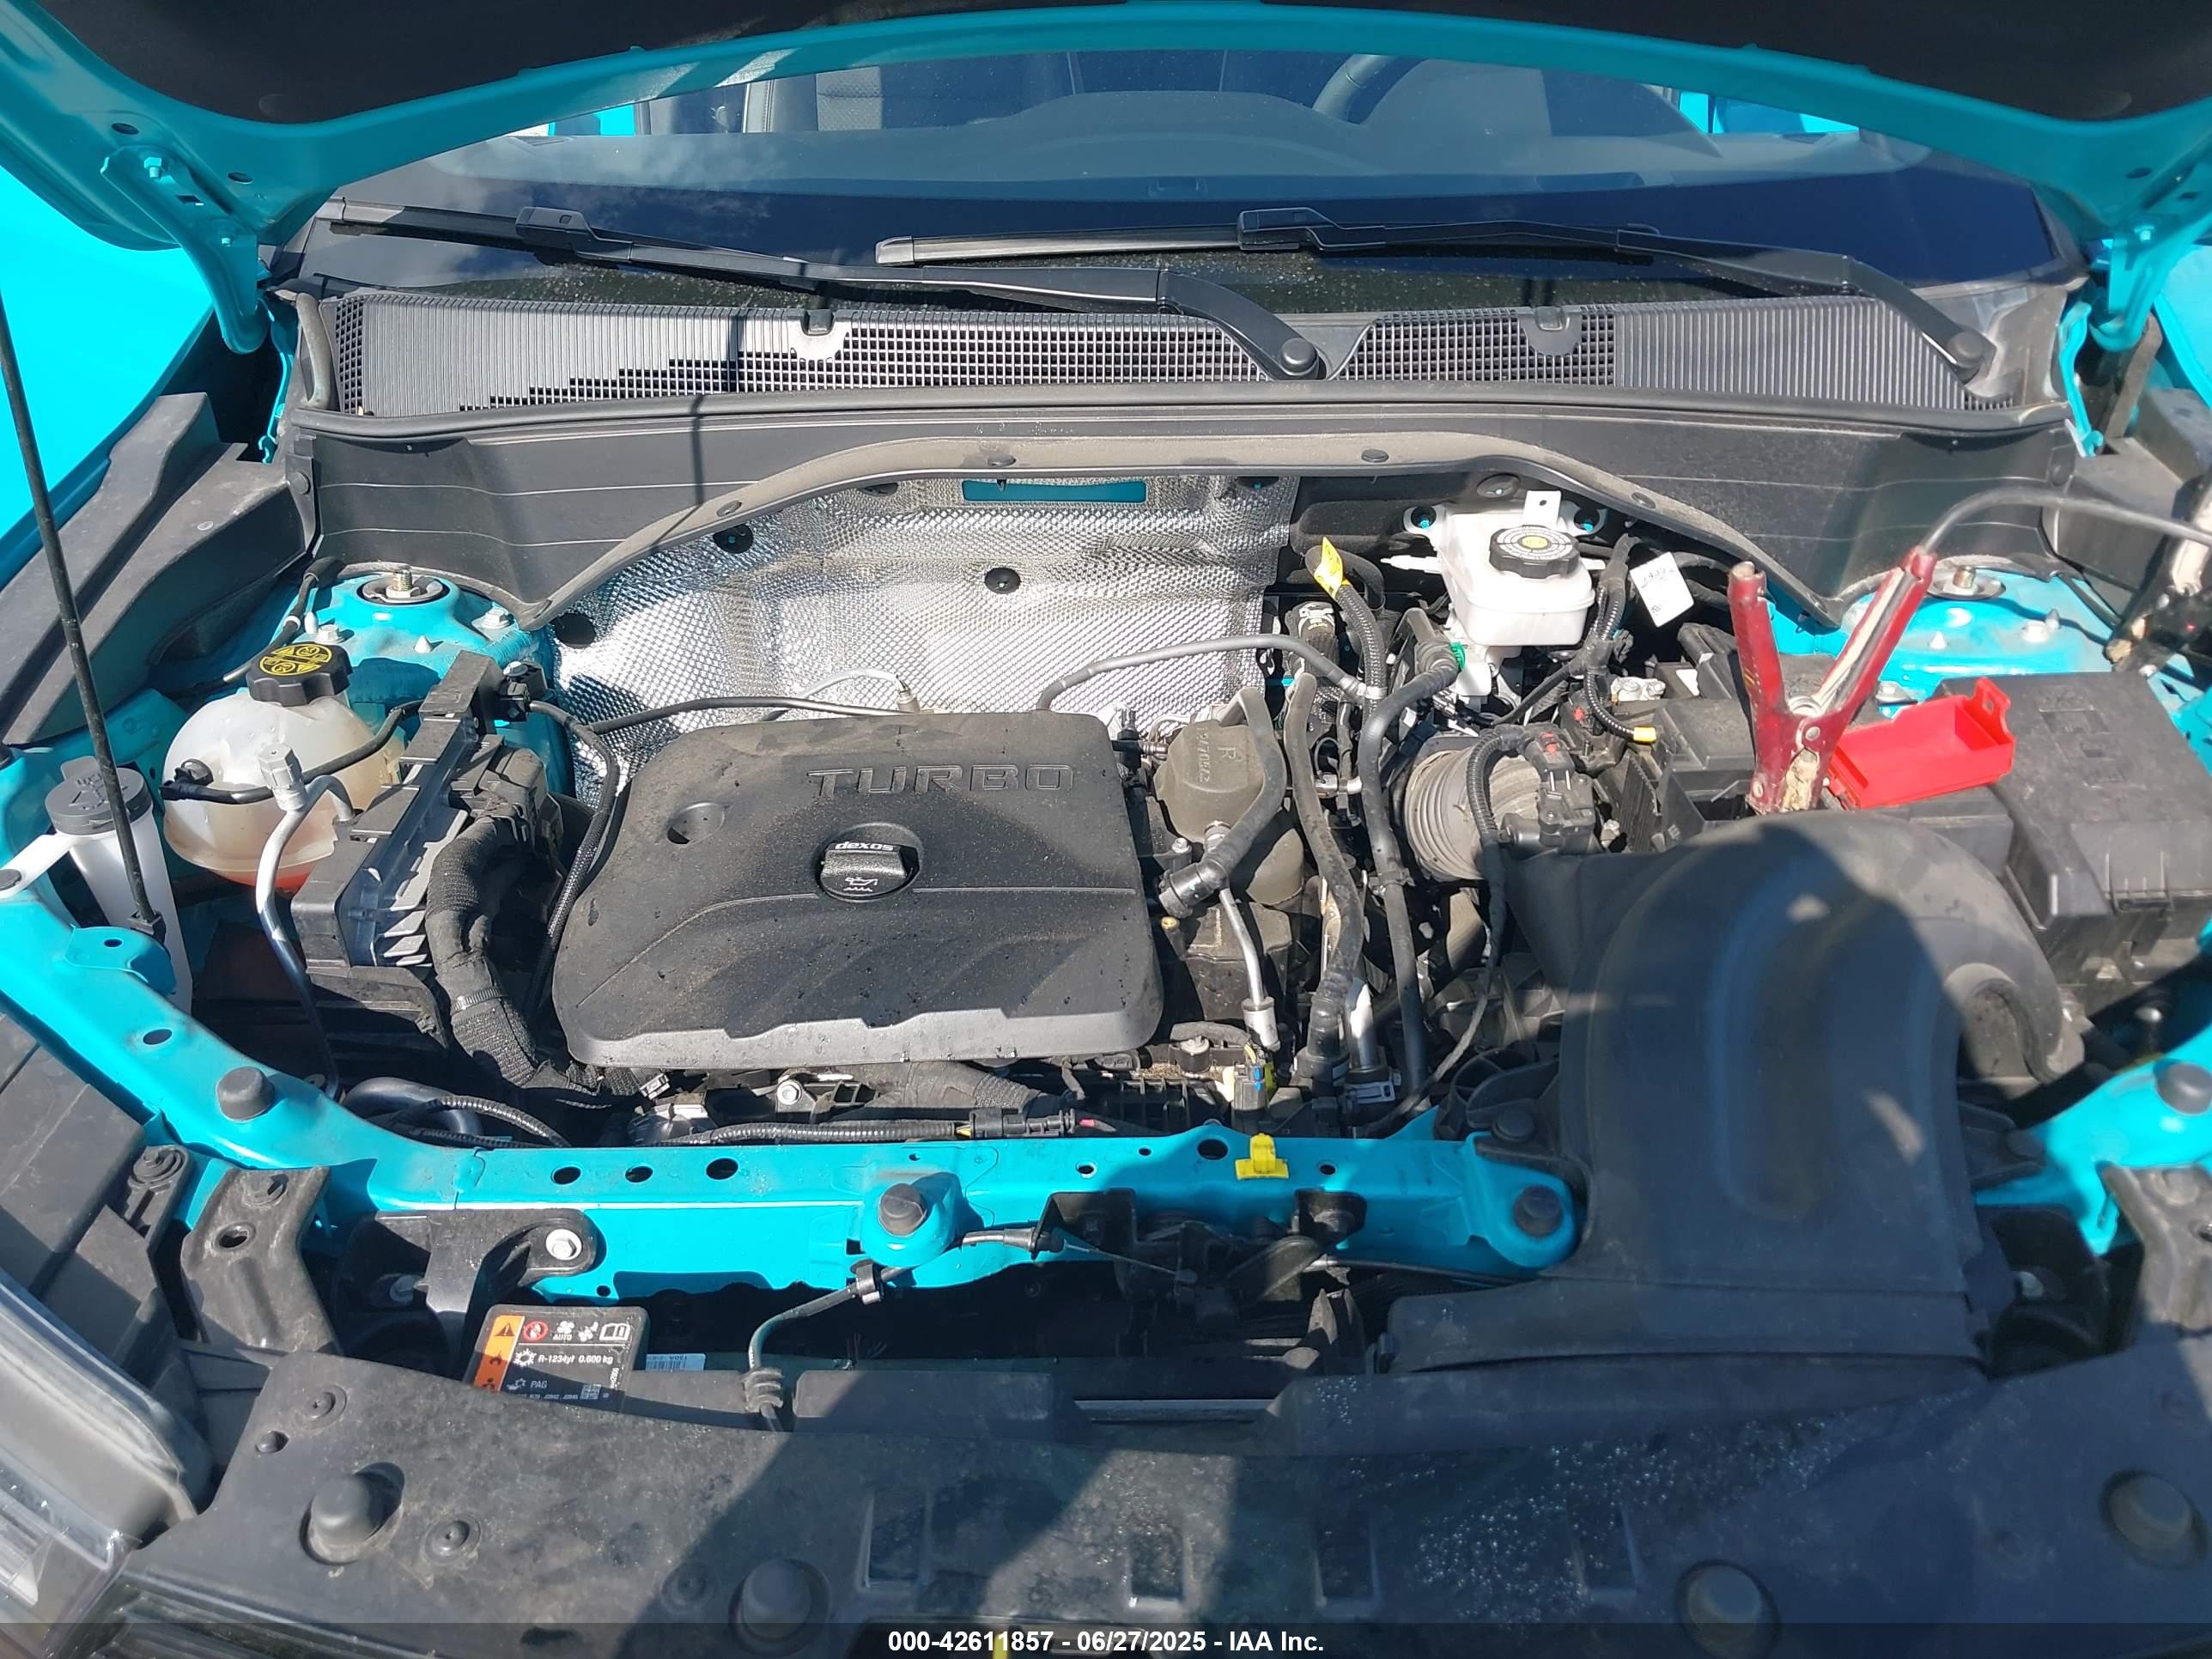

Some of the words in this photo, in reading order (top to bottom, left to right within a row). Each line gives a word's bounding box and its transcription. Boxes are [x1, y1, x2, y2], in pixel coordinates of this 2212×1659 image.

[805, 763, 1075, 798] TURBO
[835, 841, 894, 852] dexos
[538, 1354, 575, 1364] R-1234yf
[578, 1354, 602, 1364] 0.600
[603, 1354, 614, 1365] kg
[530, 1380, 548, 1389] PAG
